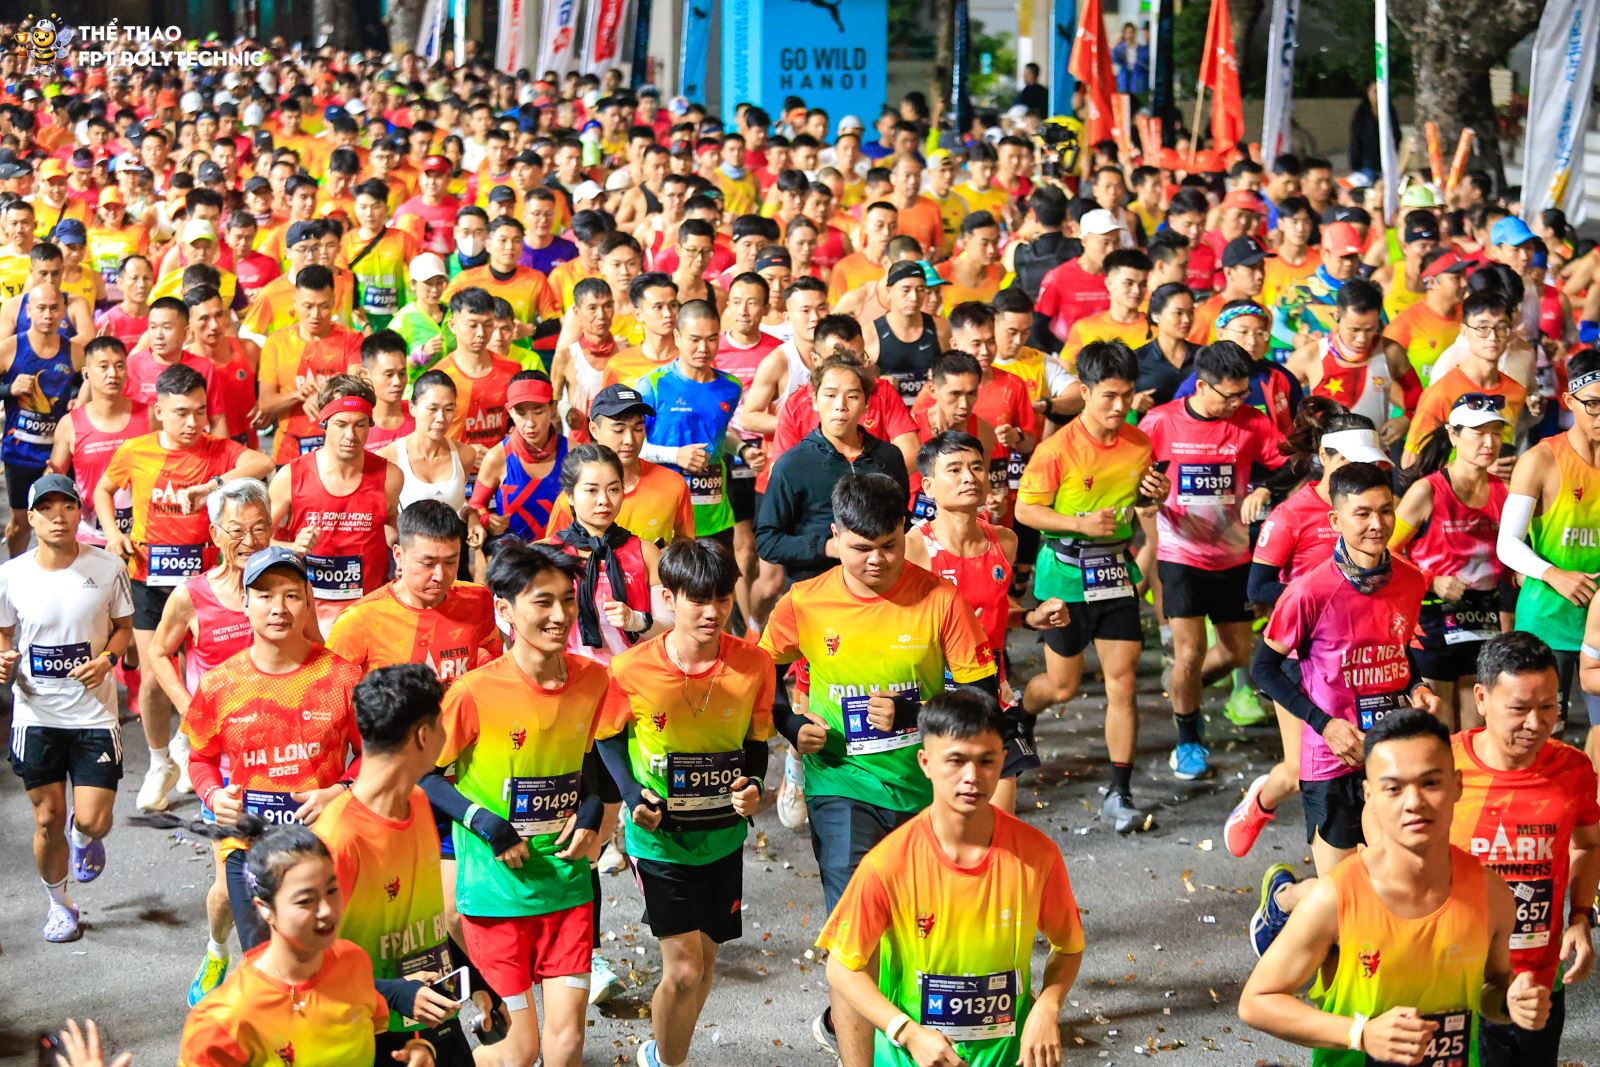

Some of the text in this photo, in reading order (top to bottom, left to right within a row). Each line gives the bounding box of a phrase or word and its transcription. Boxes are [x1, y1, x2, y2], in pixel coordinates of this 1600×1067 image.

[780, 48, 866, 71] GO WILD
[780, 74, 867, 90] HANOI
[465, 408, 503, 431] PARK
[1195, 476, 1232, 489] 91319
[322, 511, 373, 520] SONG HONG
[161, 557, 202, 570] 90652
[315, 569, 361, 583] 90026
[439, 646, 469, 659] METRI
[1341, 646, 1373, 667] LUC
[1343, 661, 1409, 688] RUNNERS
[243, 742, 320, 767] HA LONG
[268, 764, 299, 777] 2025
[674, 774, 685, 783] M
[516, 790, 578, 812] M 91499
[263, 809, 304, 826] 910
[1516, 824, 1557, 835] METRI
[1470, 819, 1556, 861] PARK
[929, 993, 1011, 1015] M 91370
[982, 1015, 994, 1024] 42
